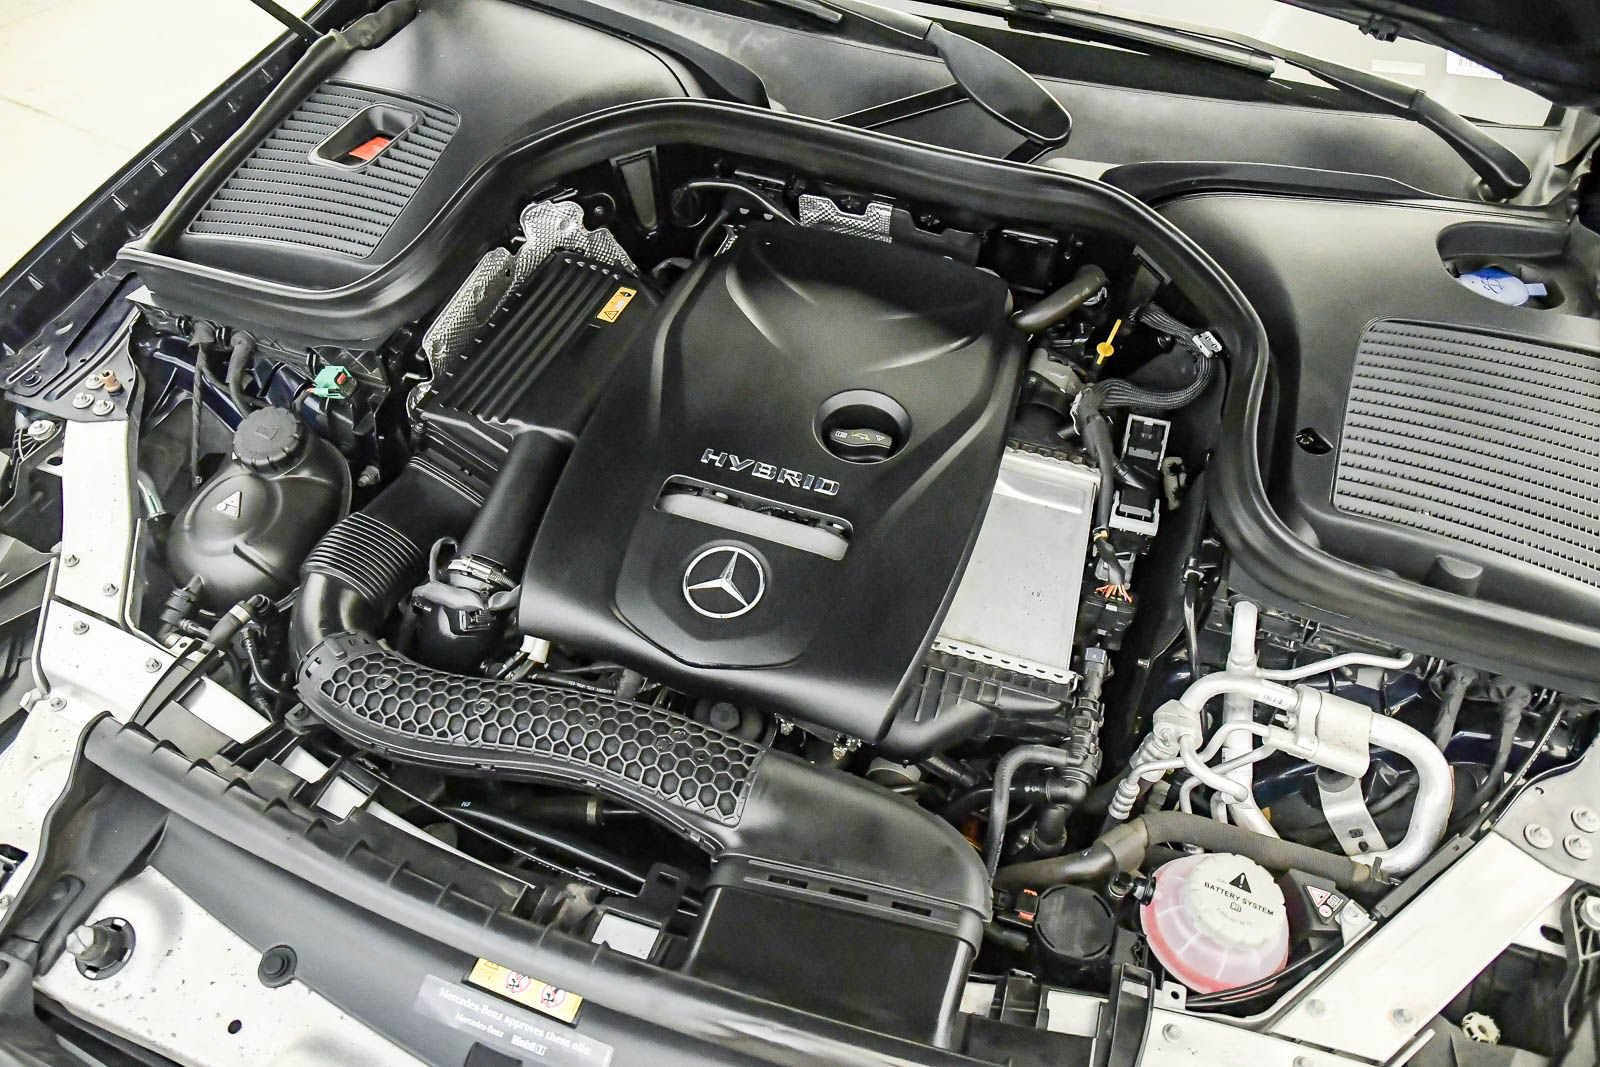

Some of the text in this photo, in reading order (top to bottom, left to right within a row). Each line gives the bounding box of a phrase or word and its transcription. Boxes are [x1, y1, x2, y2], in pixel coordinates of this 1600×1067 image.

[700, 448, 840, 496] HYBRID
[1204, 881, 1240, 901] BATTERY
[1242, 898, 1274, 916] SYSTEM
[438, 987, 503, 1022] Mercedes-Benz
[503, 1015, 545, 1038] approves
[545, 1029, 571, 1048] these
[455, 1012, 504, 1039] Mercedes-Benz
